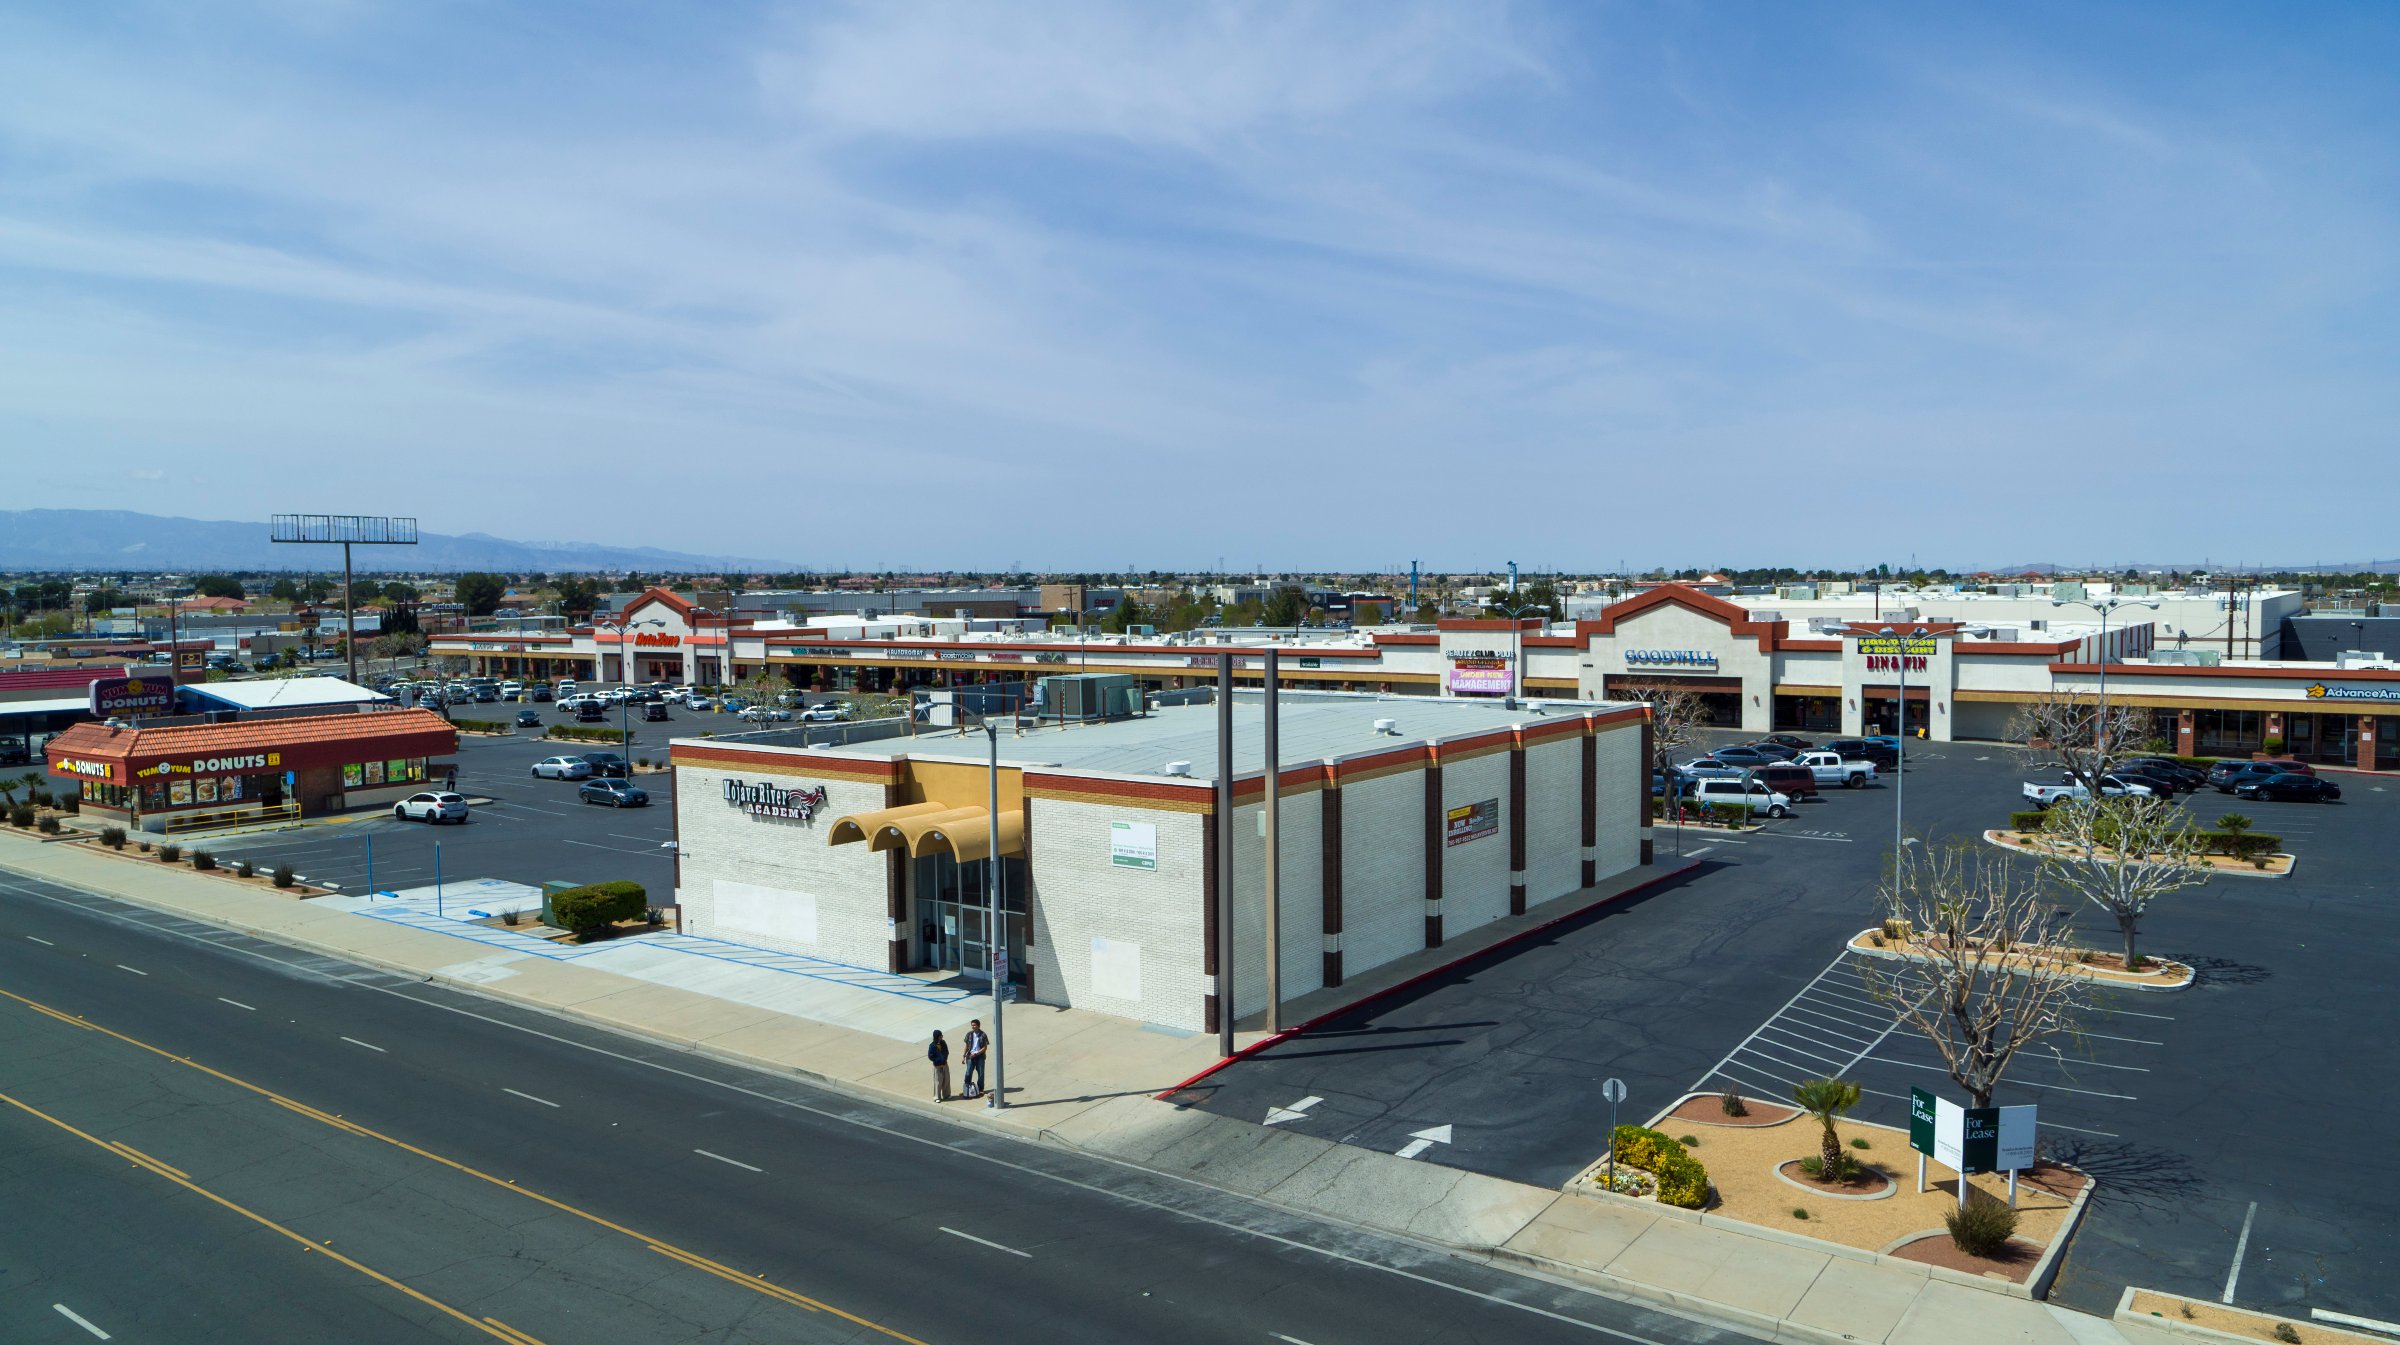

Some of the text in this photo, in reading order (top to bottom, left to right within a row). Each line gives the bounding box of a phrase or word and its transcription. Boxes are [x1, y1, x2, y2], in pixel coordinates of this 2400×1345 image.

[635, 632, 680, 648] AutoZone
[1624, 649, 1717, 664] GOODWILL
[1460, 671, 1505, 679] UNDER NEW
[102, 683, 168, 699] YUM YUM
[1452, 679, 1512, 690] MANAGEMENT
[102, 696, 167, 709] DONUTS
[75, 760, 104, 777] DONUTS
[137, 755, 266, 778] YUM YUM DONUTS
[723, 780, 787, 806] Mojave River
[747, 804, 809, 820] ACADEMY
[1912, 1094, 1925, 1109] For
[1912, 1105, 1934, 1124] Lease
[1966, 1117, 1983, 1129] For
[1966, 1129, 1995, 1140] Lease
